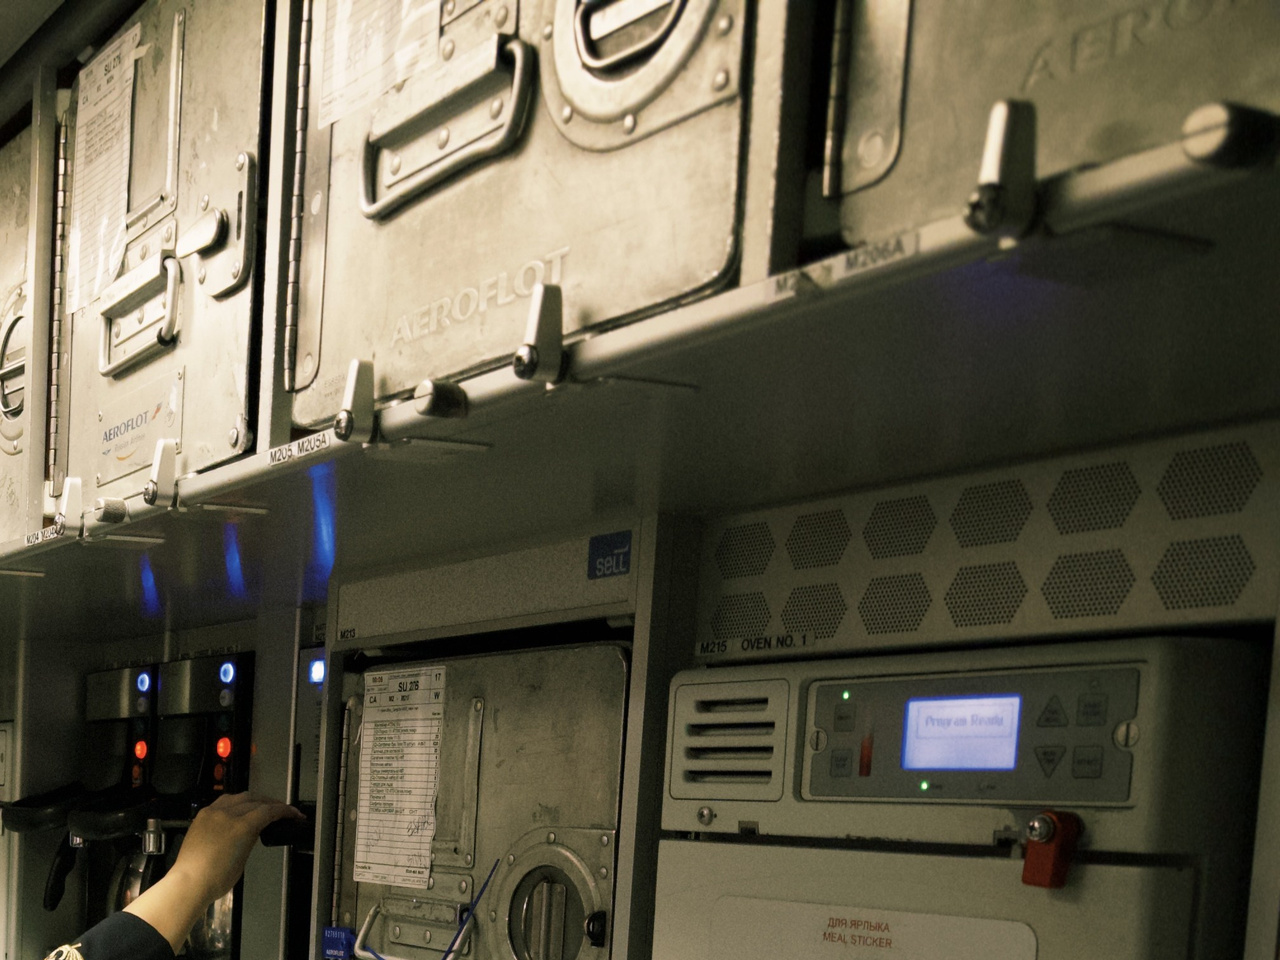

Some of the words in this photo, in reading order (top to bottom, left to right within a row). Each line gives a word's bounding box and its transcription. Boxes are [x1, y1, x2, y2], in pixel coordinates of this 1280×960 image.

[391, 246, 570, 348] AEROFLOT
[102, 410, 149, 444] AEROFLOT
[269, 444, 293, 463] M205
[297, 433, 327, 456] M205A
[341, 628, 356, 639] M213
[741, 637, 772, 651] OVEN
[776, 634, 797, 648] NO.
[801, 633, 807, 646] 1
[700, 641, 728, 654] M215
[398, 682, 408, 692] SU
[827, 917, 848, 929] ДЛЯ
[850, 919, 891, 933] ЯРЛЫКА
[823, 931, 847, 944] MEAL
[850, 934, 893, 949] STICKER
